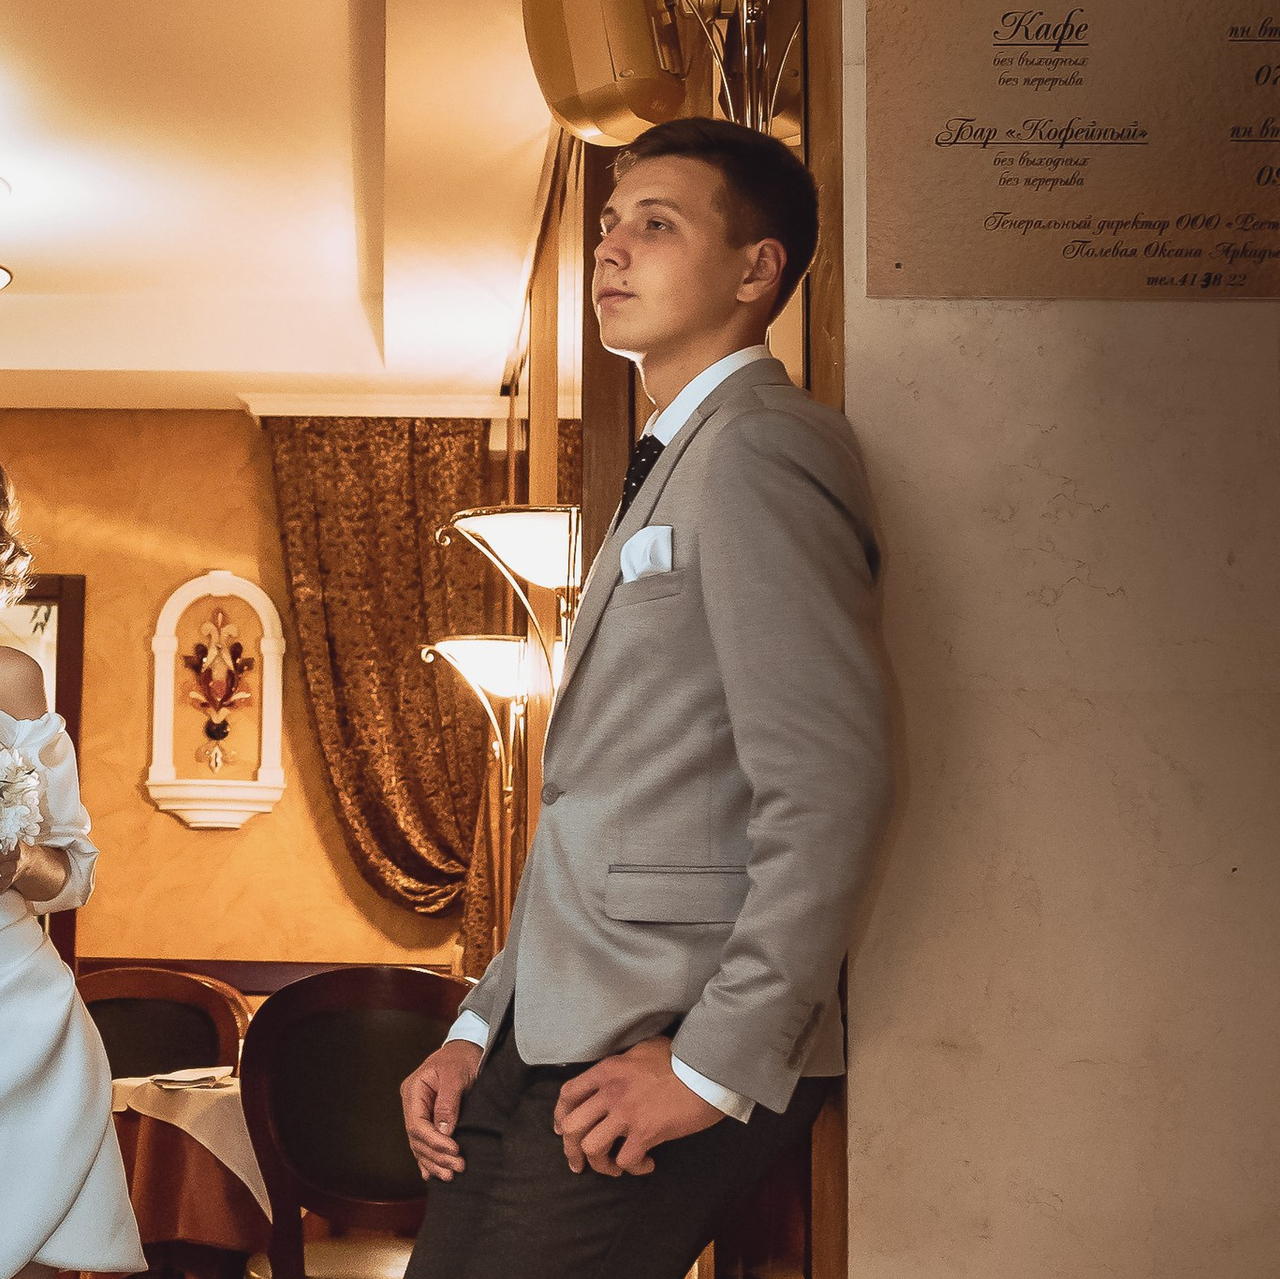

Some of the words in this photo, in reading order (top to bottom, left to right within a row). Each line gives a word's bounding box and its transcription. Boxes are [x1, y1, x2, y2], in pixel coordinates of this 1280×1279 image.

[992, 8, 1090, 52] Кафе
[993, 51, 1015, 68] без
[1018, 51, 1089, 72] выходных
[998, 72, 1019, 87] без
[1021, 72, 1084, 91] перерыва
[934, 118, 998, 149] Бар
[1005, 116, 1149, 149] «Кофейный»
[993, 151, 1015, 168] без
[1018, 151, 1090, 172] выходных
[998, 171, 1020, 187] без
[1021, 171, 1085, 192] перерыва
[983, 211, 1093, 237] Генеральный
[1096, 211, 1171, 236] директор
[1175, 212, 1221, 231] ООО
[1061, 240, 1139, 261] Полевая
[1142, 240, 1203, 260] Оксана
